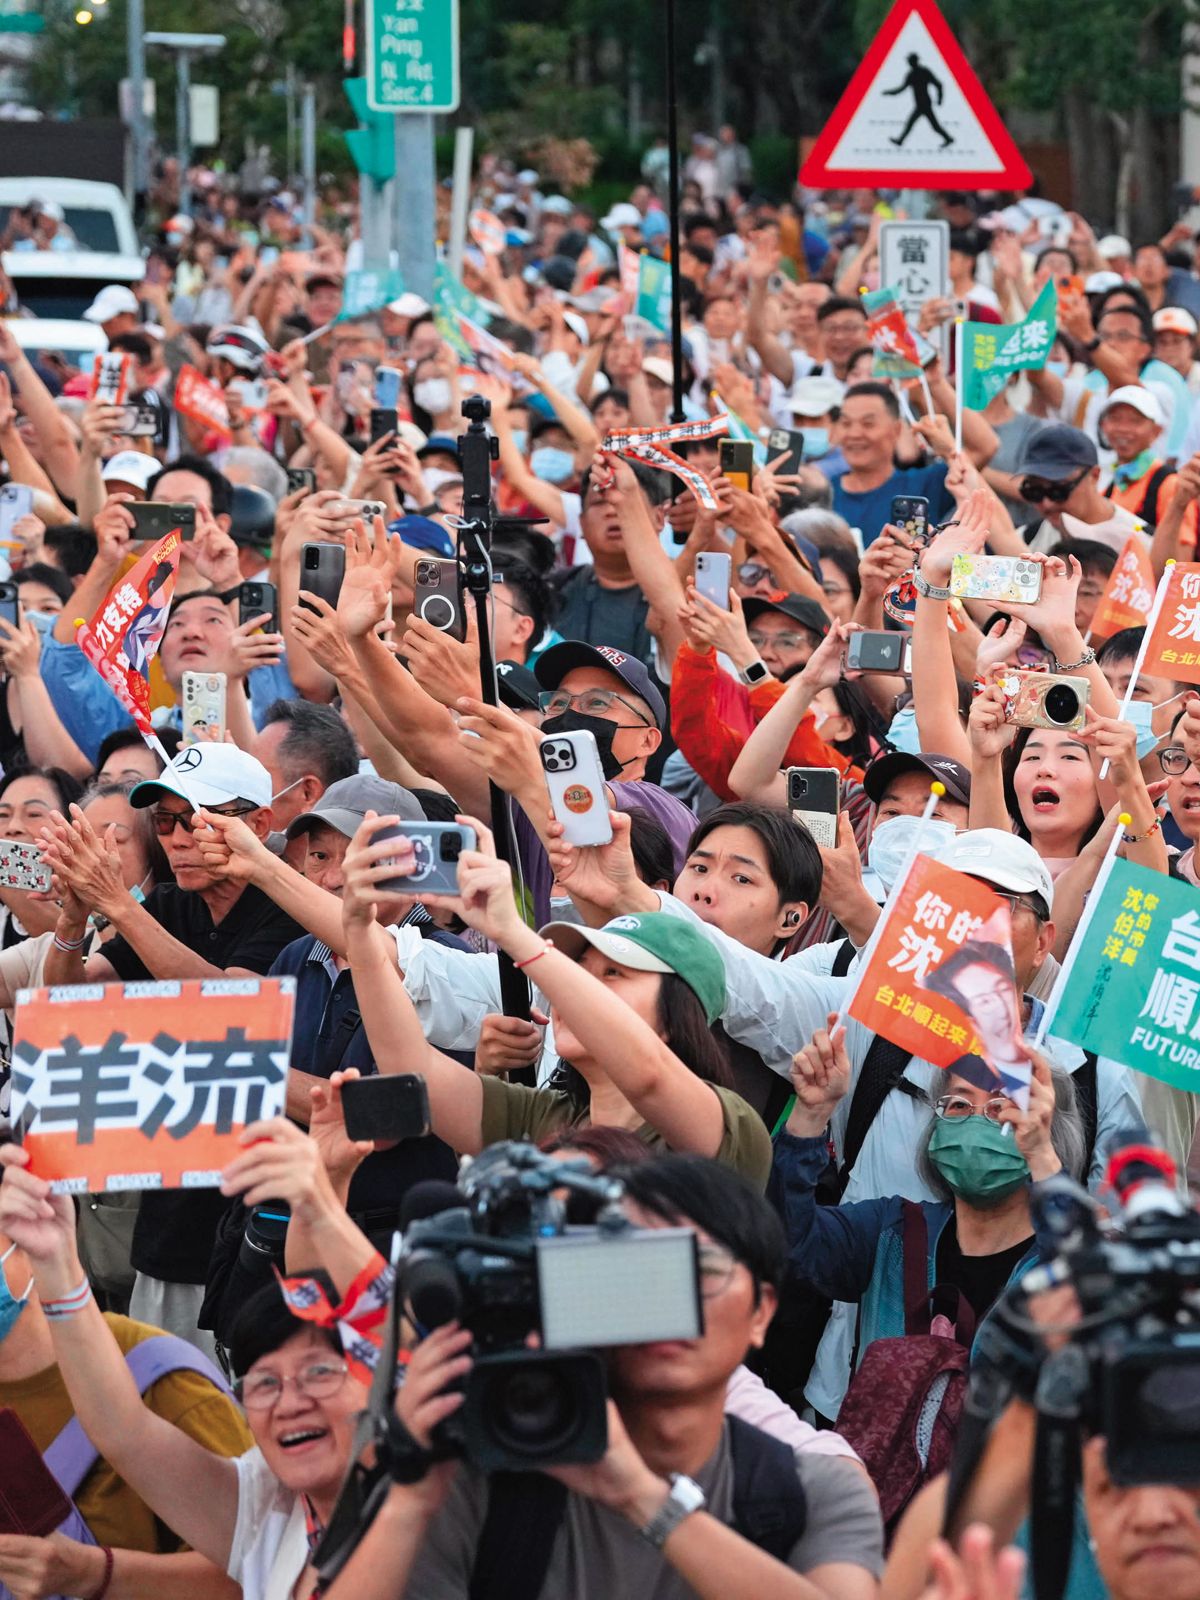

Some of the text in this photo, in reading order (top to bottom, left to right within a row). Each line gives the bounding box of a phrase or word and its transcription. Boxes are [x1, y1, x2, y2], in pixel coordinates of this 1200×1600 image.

[381, 15, 418, 34] Yan
[381, 34, 422, 59] Ping
[897, 234, 930, 310] 當心
[1103, 886, 1143, 960] 沈伯洋
[874, 984, 969, 1047] 台北順起來
[11, 1027, 290, 1145] 洋流
